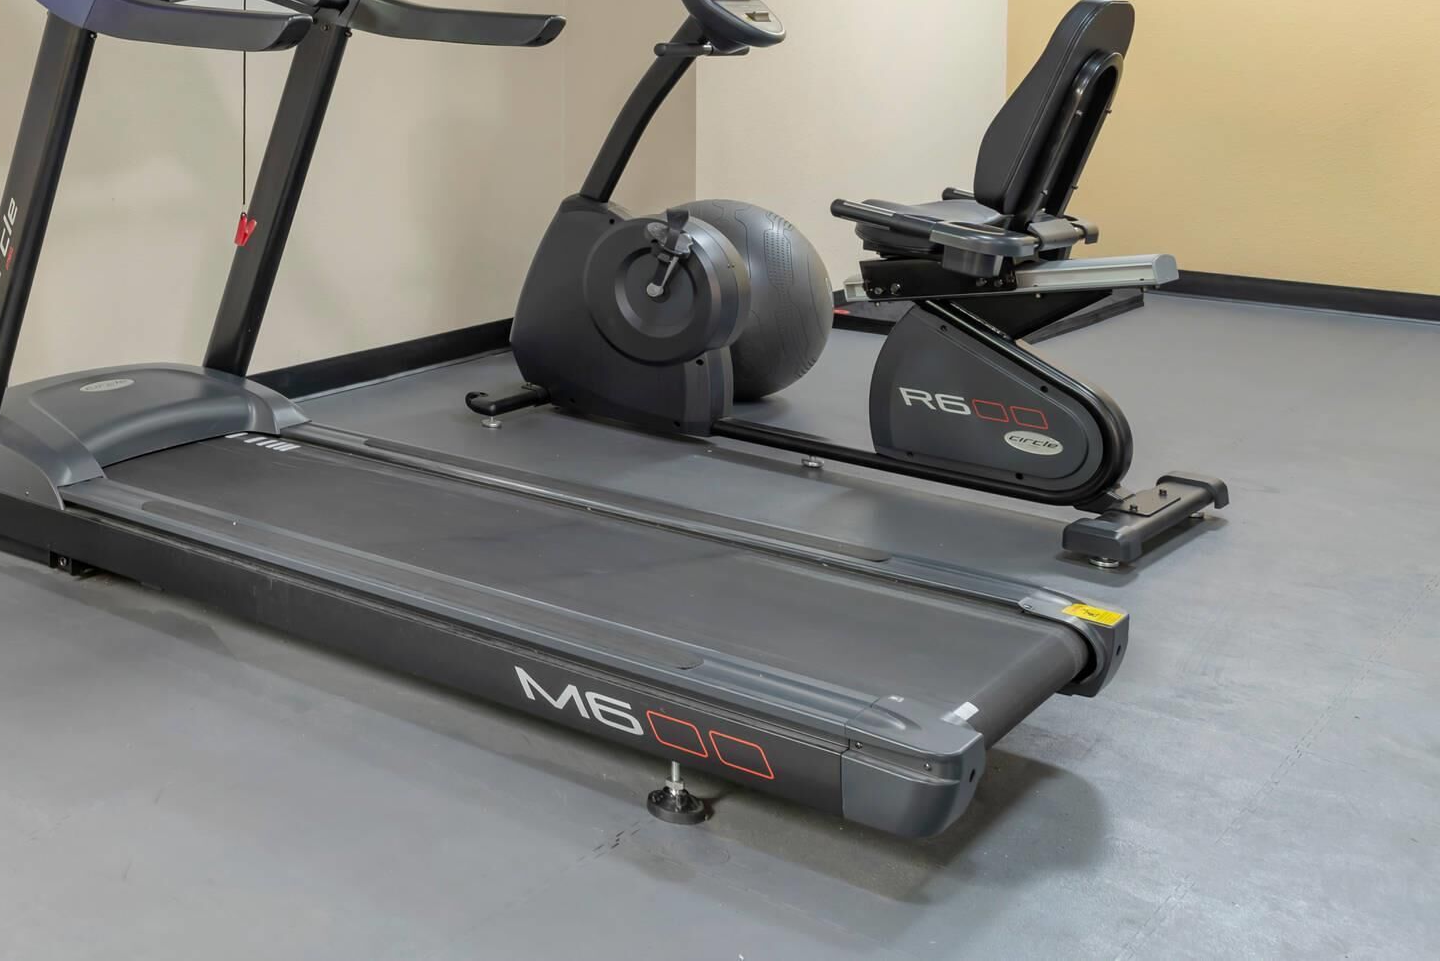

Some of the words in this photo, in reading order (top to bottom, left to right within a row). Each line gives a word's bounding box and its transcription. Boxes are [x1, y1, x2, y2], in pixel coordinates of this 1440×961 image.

[899, 387, 1049, 430] R600
[1008, 434, 1059, 450] circle
[514, 665, 776, 780] M600
